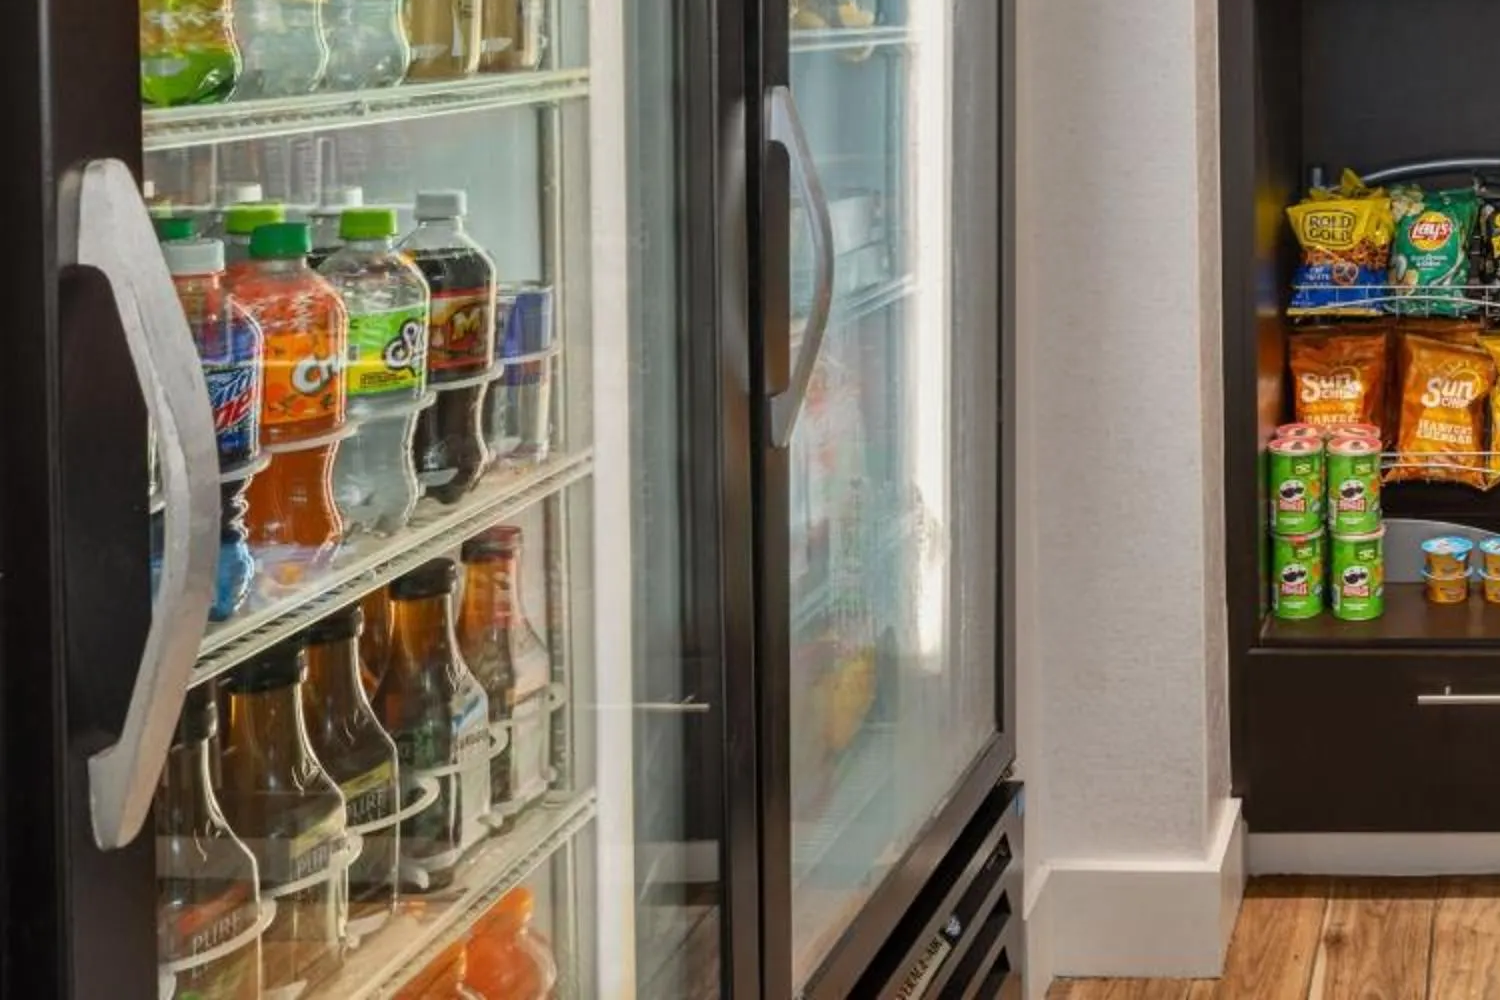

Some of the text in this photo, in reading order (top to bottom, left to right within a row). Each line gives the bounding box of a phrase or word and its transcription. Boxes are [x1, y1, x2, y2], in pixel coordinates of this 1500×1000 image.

[1308, 214, 1353, 229] ROLD
[1411, 221, 1453, 241] Lay's
[1308, 228, 1353, 245] GOLD
[1301, 372, 1352, 403] Sun
[1420, 376, 1476, 409] Sun
